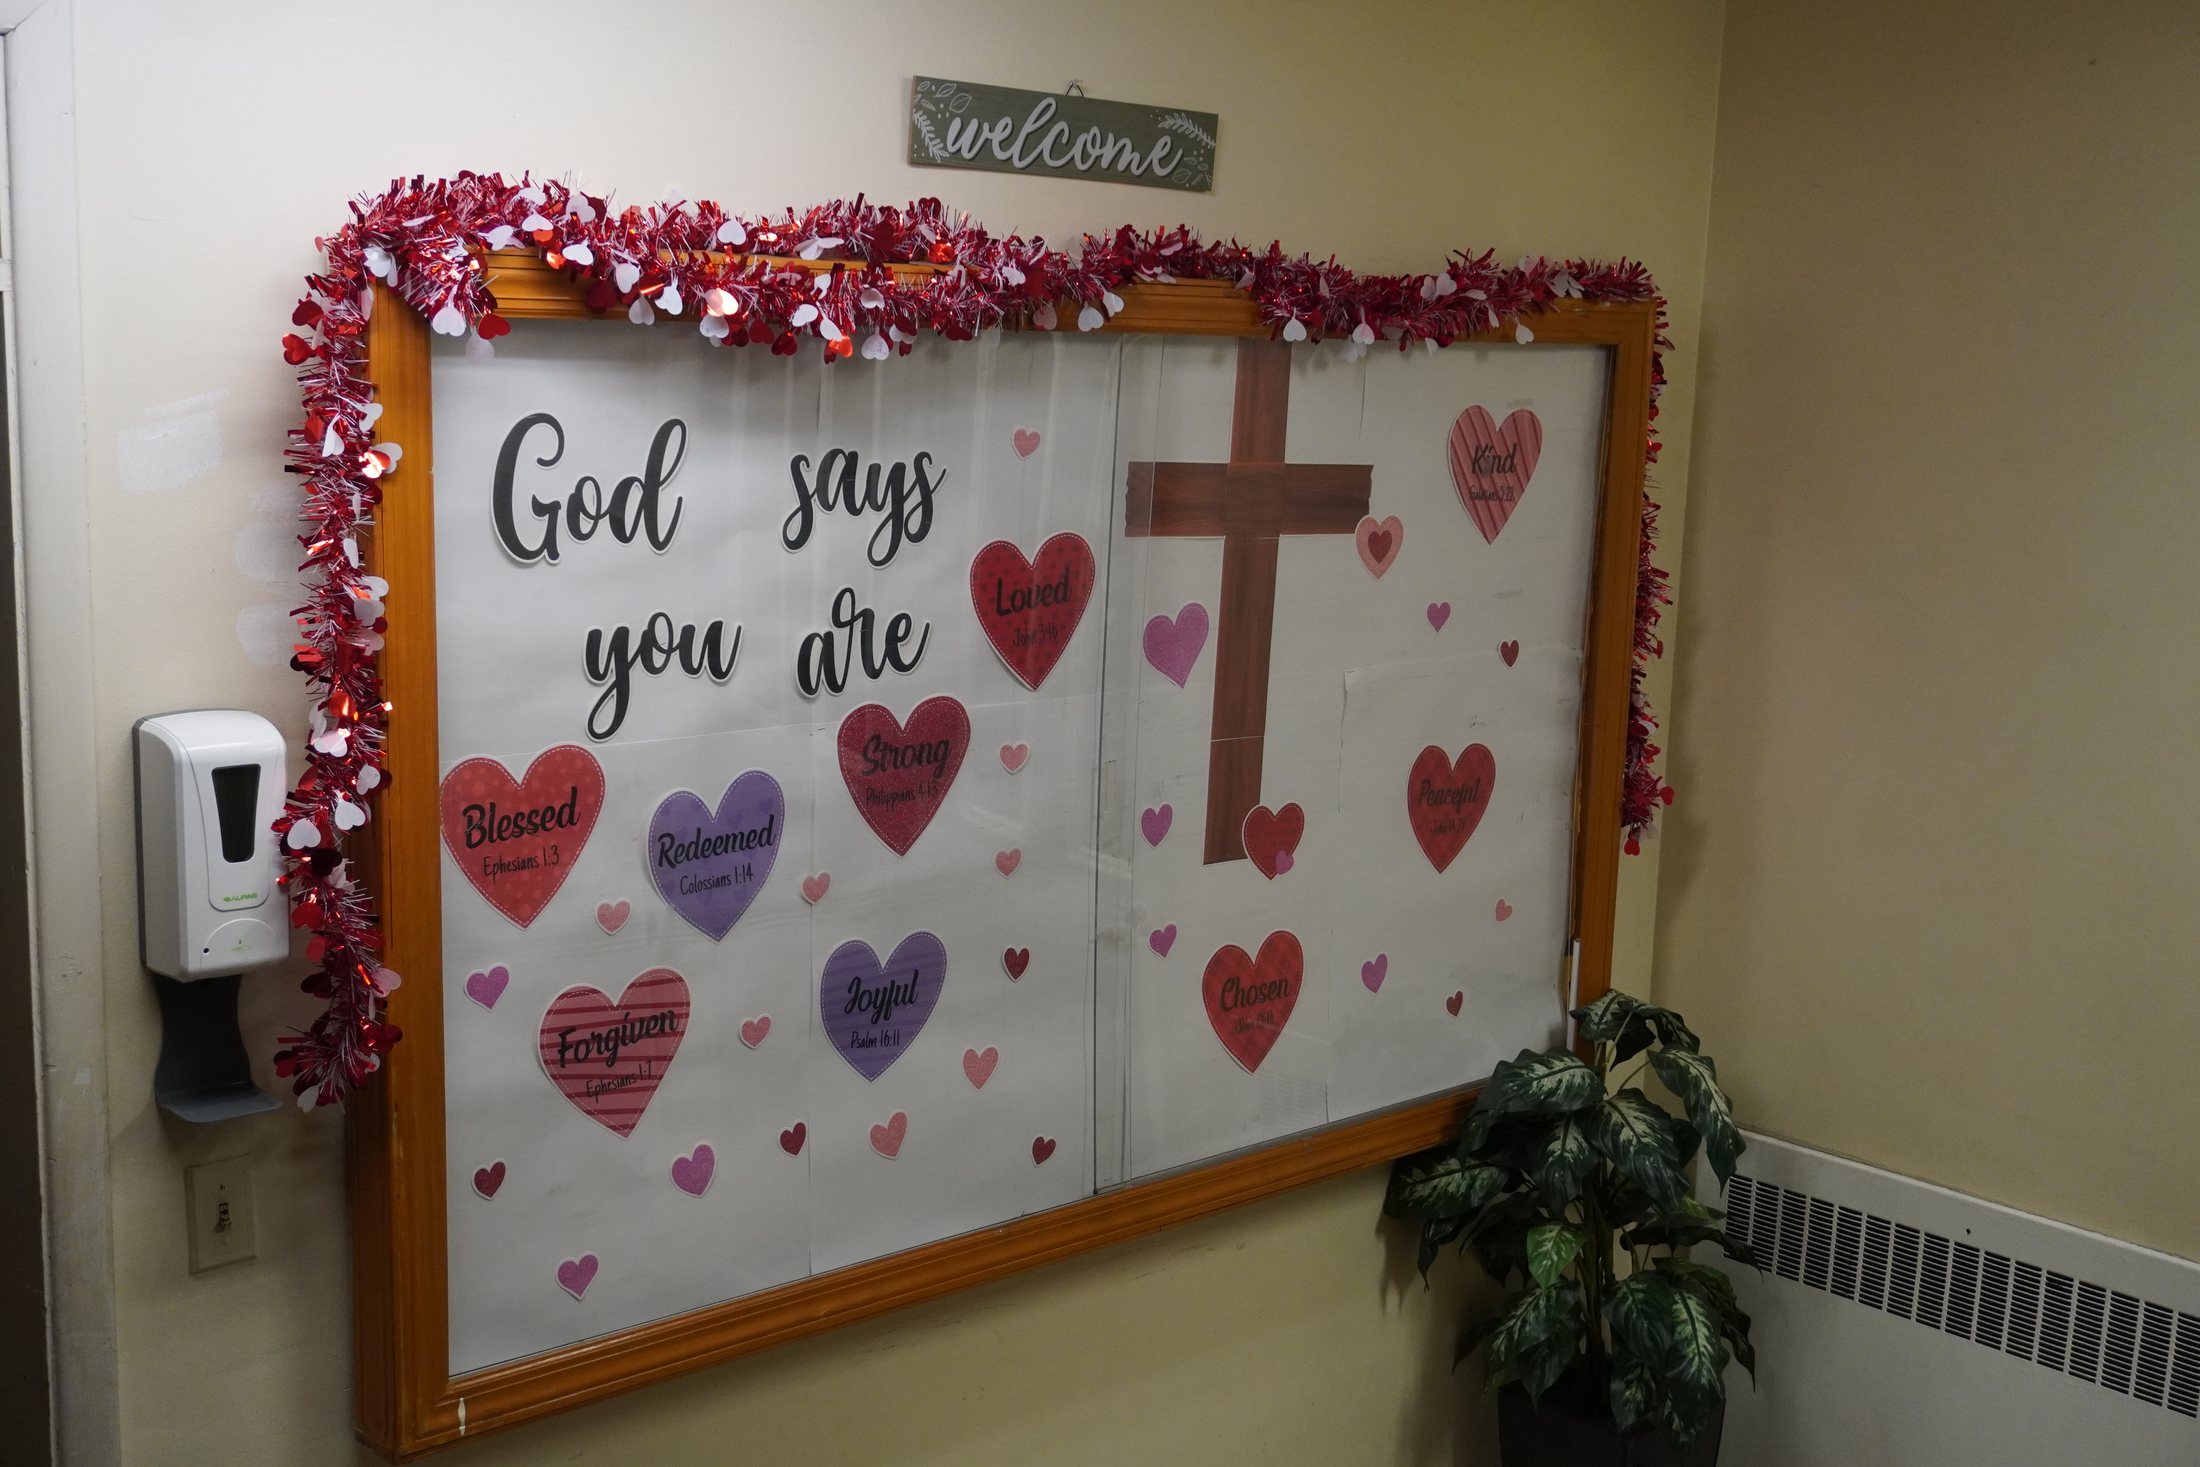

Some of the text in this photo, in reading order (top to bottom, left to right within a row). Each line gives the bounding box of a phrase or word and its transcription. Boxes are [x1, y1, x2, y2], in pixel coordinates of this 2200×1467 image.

[946, 96, 1184, 177] welcome
[492, 412, 946, 568] God says
[996, 566, 1070, 617] Loved
[585, 587, 930, 740] you are
[861, 733, 950, 779] Strong
[462, 785, 581, 849] Blessed
[1417, 776, 1481, 814] Peaceful
[483, 845, 560, 883] Ephesians 1:3
[657, 814, 777, 870] Redeemed
[680, 862, 754, 896] Colossians 1:14
[844, 969, 919, 1024] Joyful
[1220, 976, 1289, 1012] Chosen
[557, 1009, 679, 1068] Forgiven
[850, 1028, 900, 1049] Psalm 16:11
[586, 1060, 652, 1104] Ephesians 1:7
